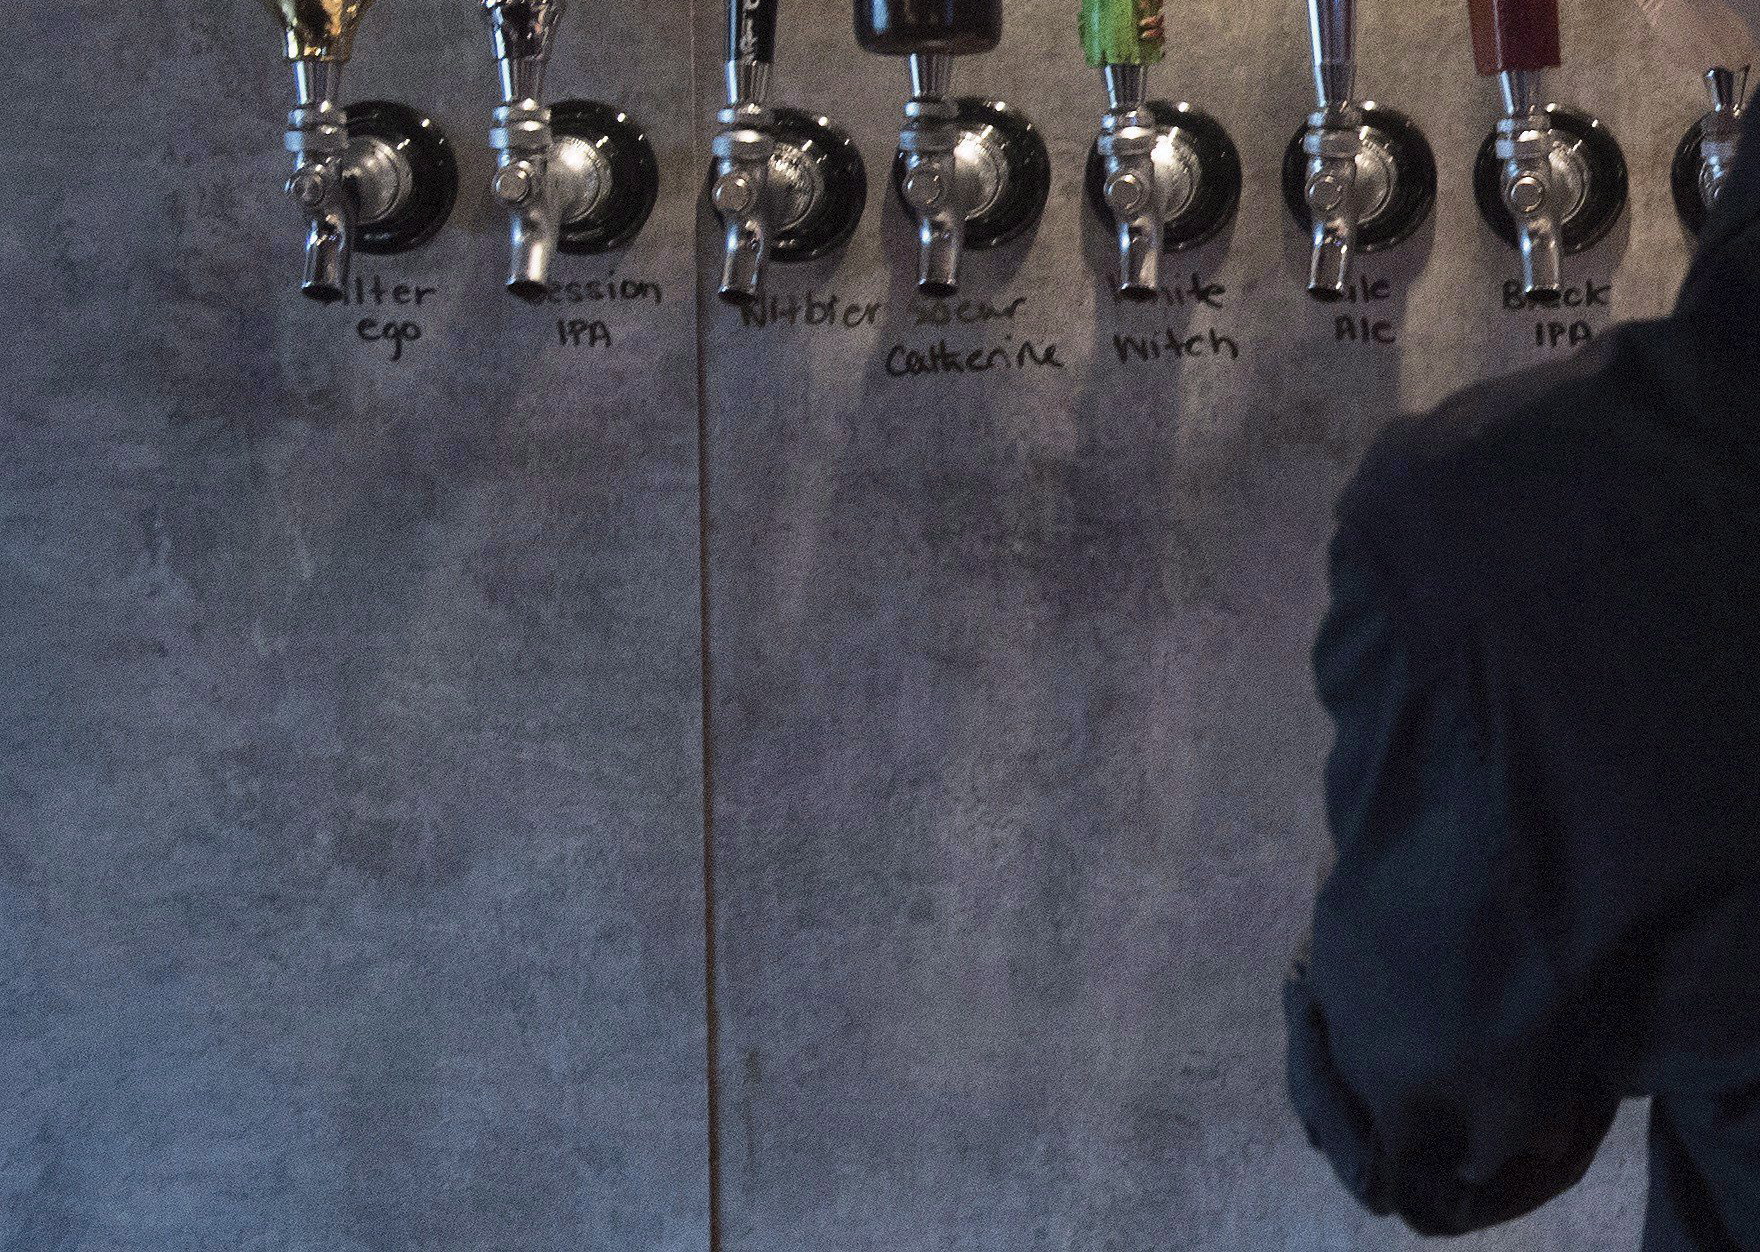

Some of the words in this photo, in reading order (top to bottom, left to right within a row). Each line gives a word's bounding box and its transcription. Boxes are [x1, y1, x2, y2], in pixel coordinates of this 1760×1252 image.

[343, 274, 438, 305] lter
[547, 270, 663, 305] ession
[356, 317, 423, 363] ego
[557, 317, 614, 348] IPA
[1112, 327, 1239, 364] Witch
[1333, 315, 1397, 346] Ale
[1534, 319, 1592, 348] IPA
[885, 333, 1066, 378] Catherine
